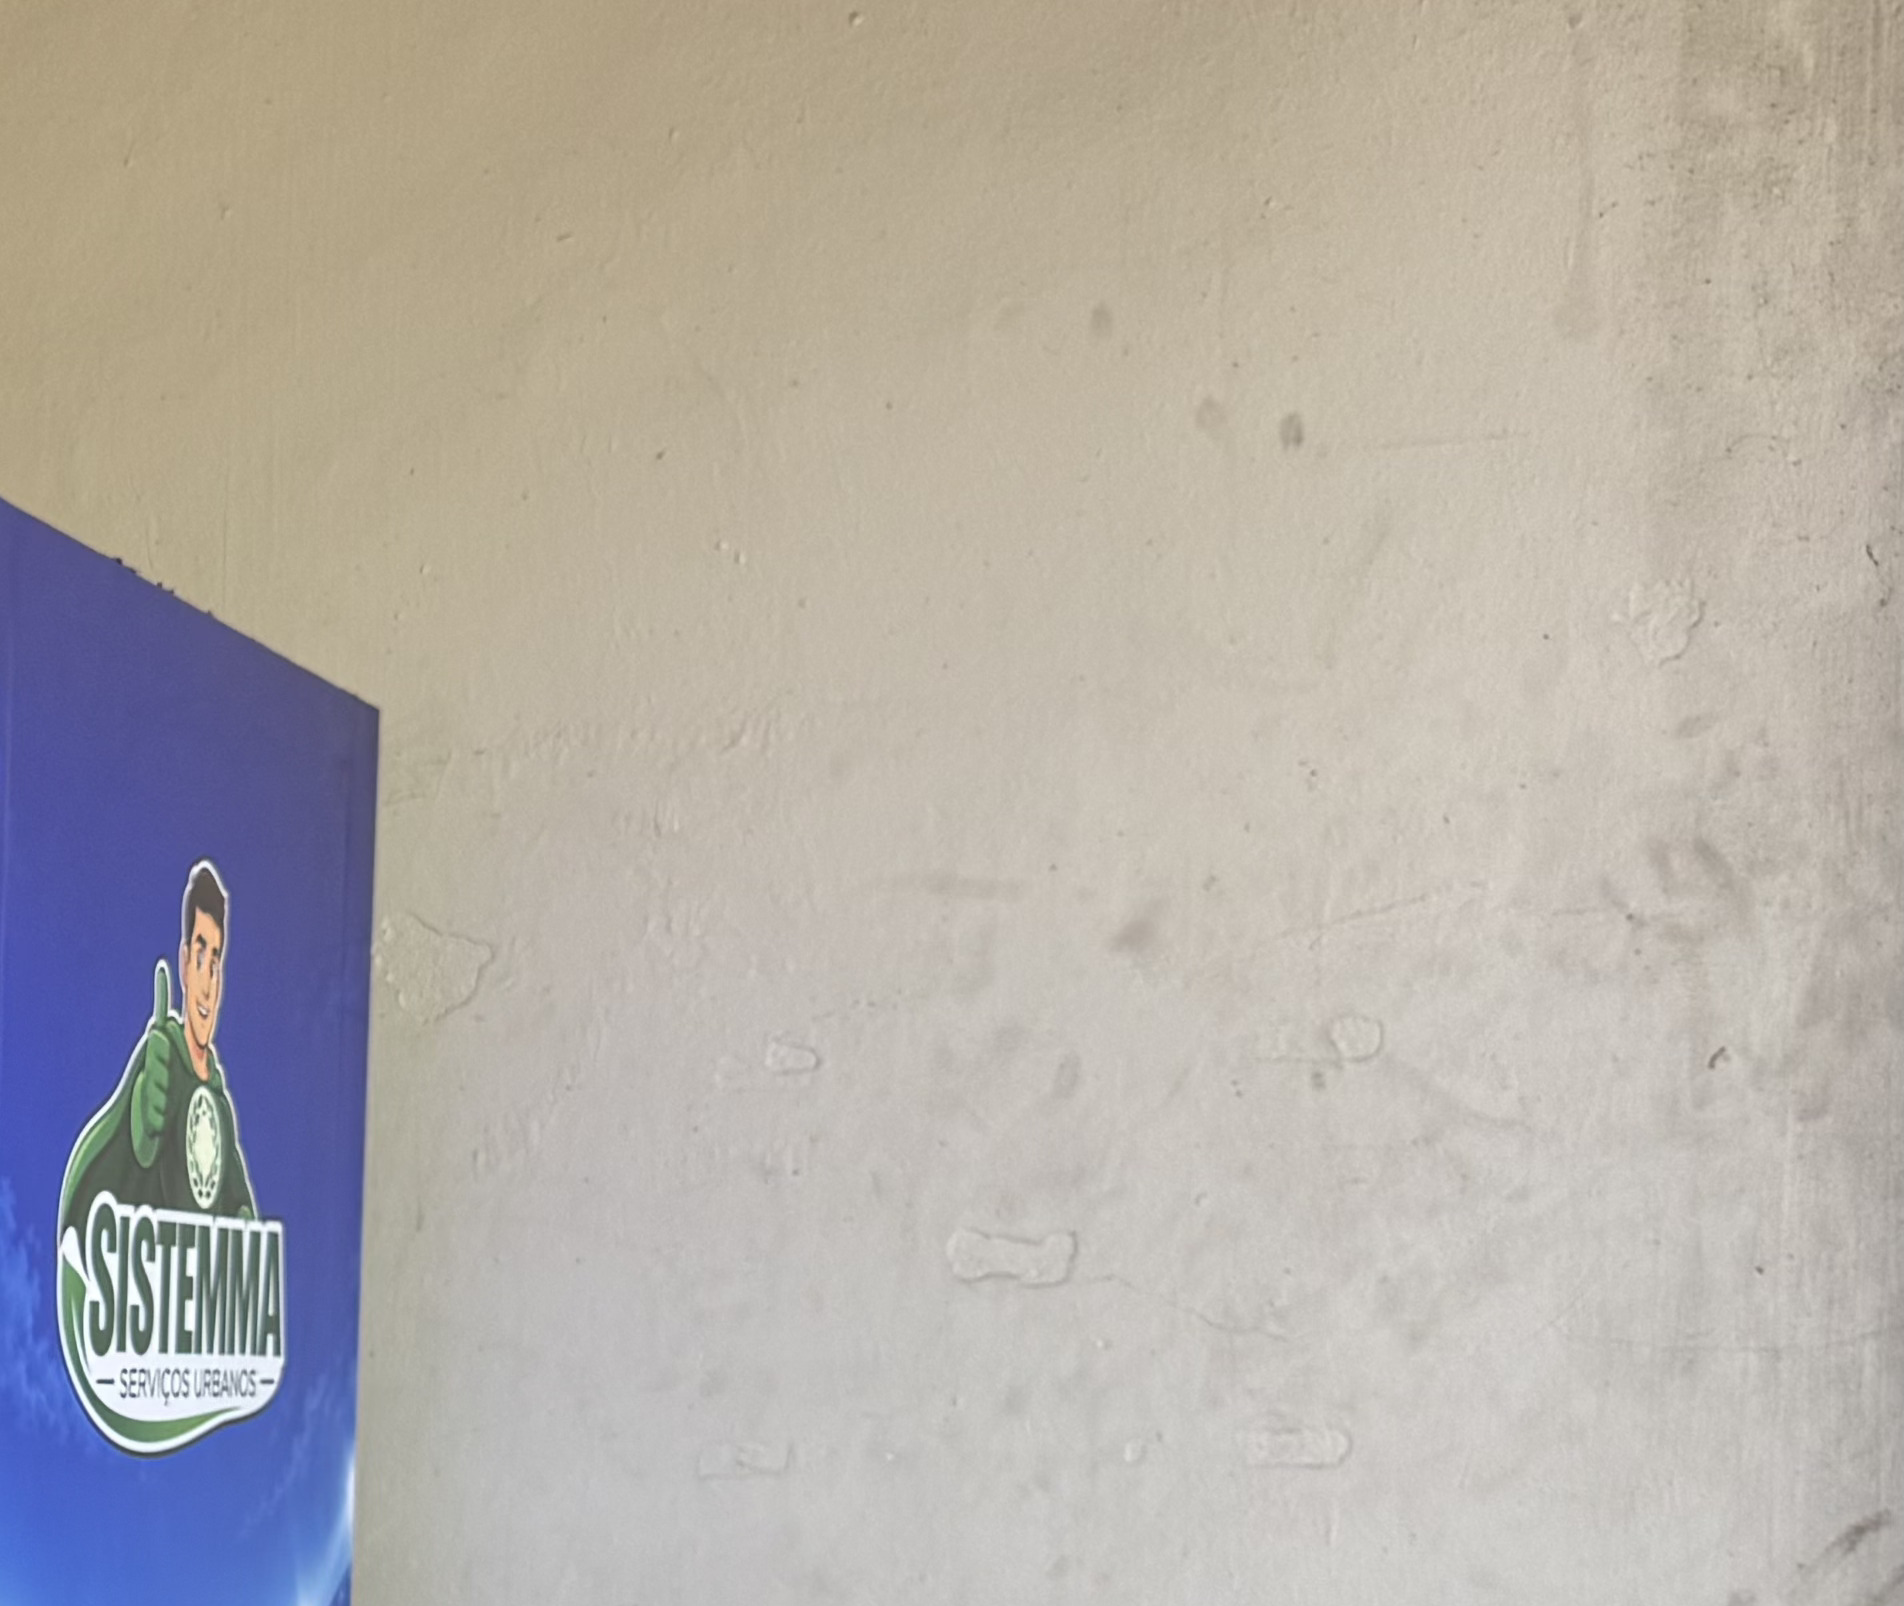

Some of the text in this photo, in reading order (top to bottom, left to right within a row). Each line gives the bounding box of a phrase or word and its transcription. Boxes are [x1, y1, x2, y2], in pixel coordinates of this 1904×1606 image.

[89, 1203, 282, 1358] SISTEMMA
[119, 1366, 257, 1404] SERVIÇOS URBANOS
